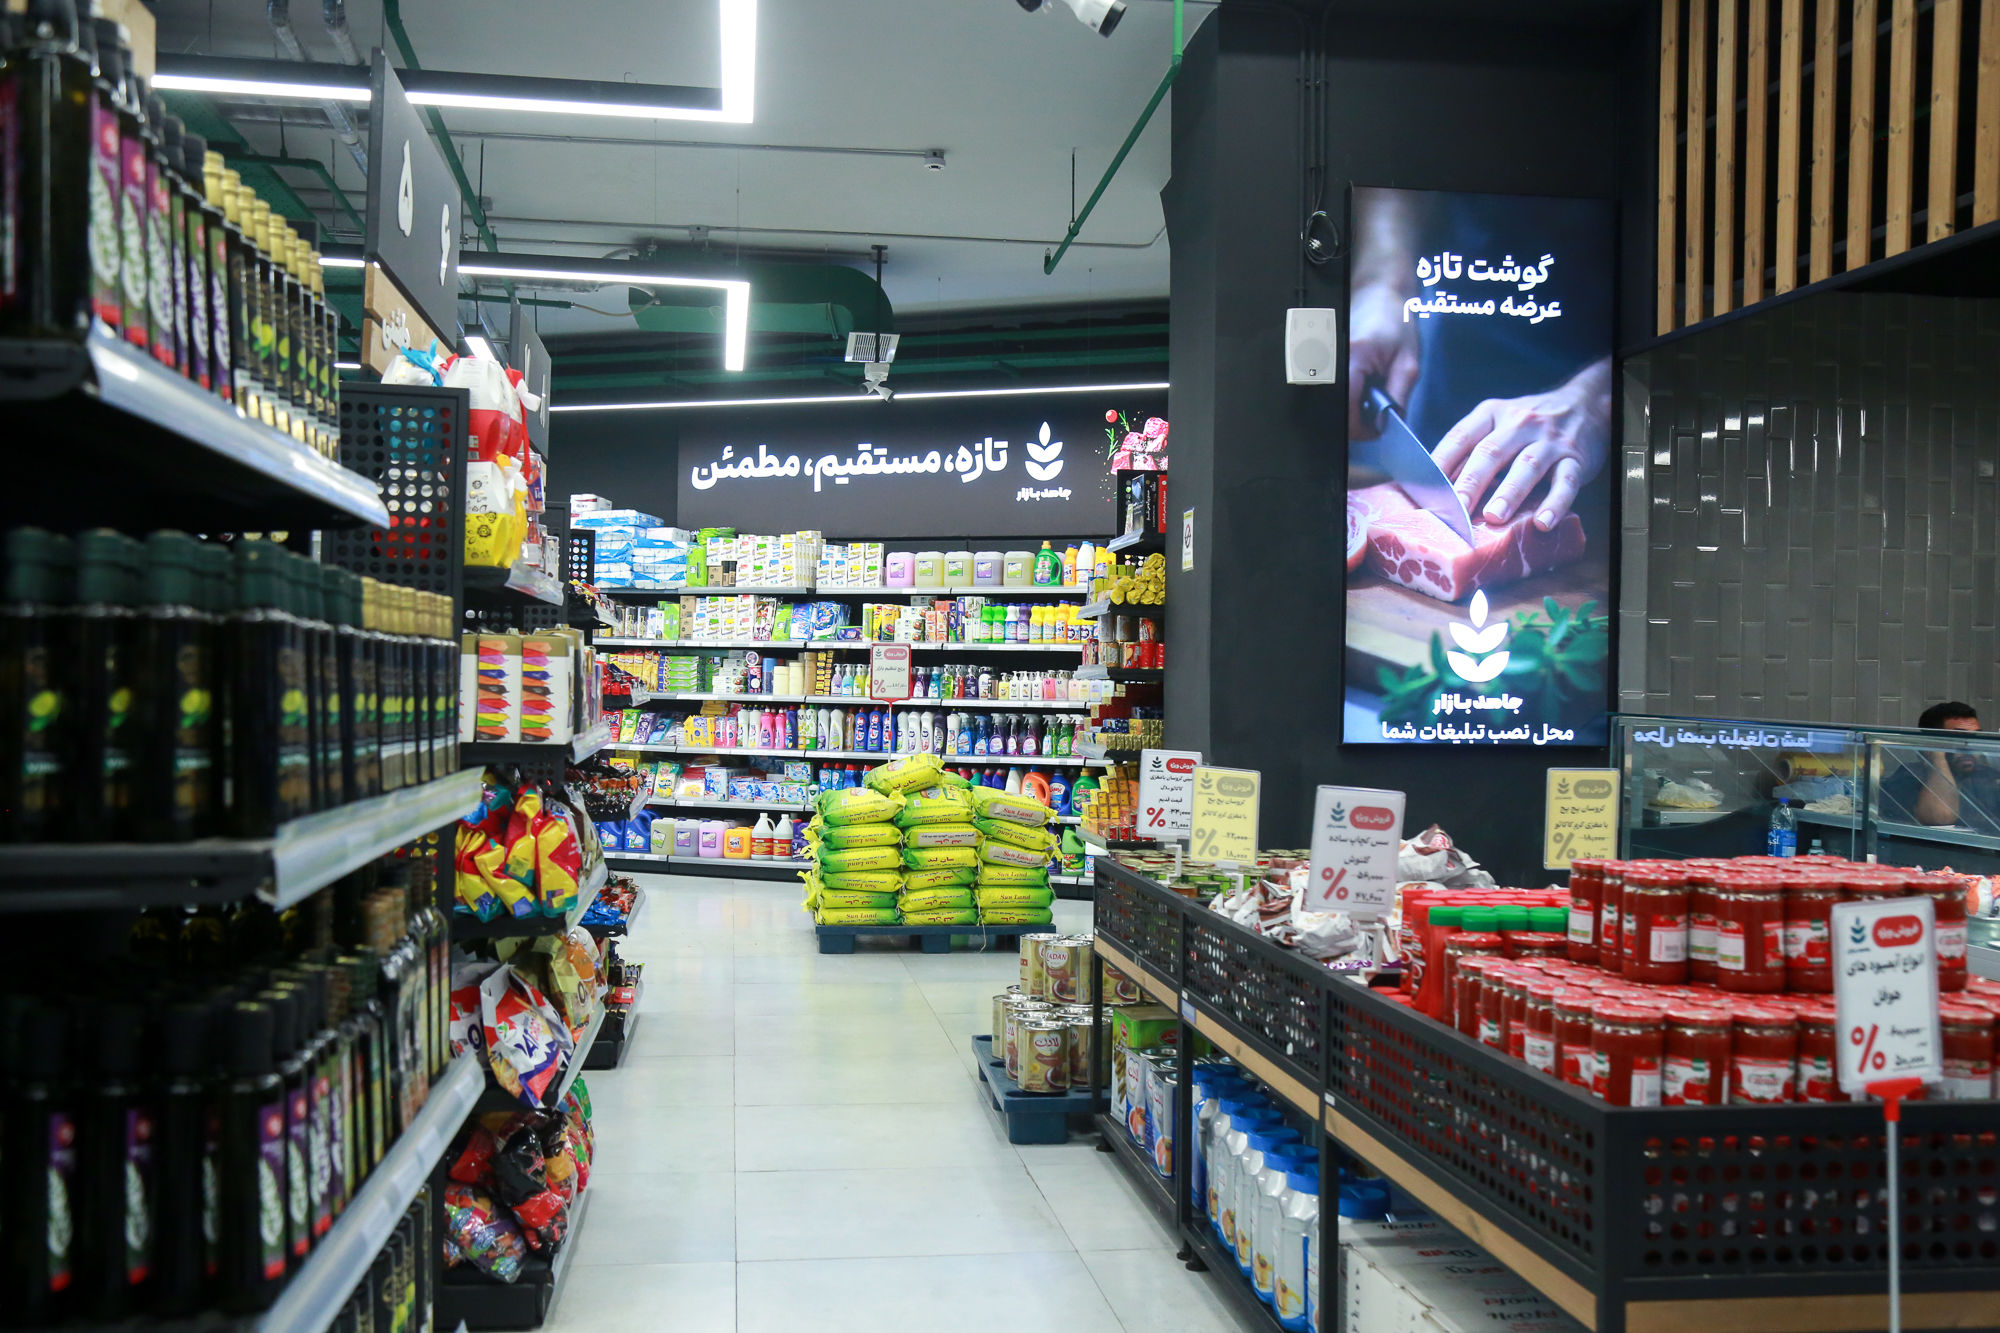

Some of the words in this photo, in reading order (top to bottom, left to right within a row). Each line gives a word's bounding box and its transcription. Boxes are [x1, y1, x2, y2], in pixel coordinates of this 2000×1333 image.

[1416, 251, 1462, 287] تازه
[1467, 253, 1555, 292] گوشت
[1403, 290, 1496, 323] مستقیم
[1500, 294, 1562, 324] عرضه
[691, 445, 800, 490] مطمئن
[804, 442, 941, 492] مستقیم،
[945, 437, 1009, 484] تازه،
[1432, 693, 1473, 716] بازار
[1381, 721, 1417, 740] شما
[1419, 722, 1486, 745] تبلیغات
[1487, 723, 1530, 745] نصب
[1532, 723, 1575, 746] محل
[1002, 807, 1017, 815] Sun
[1017, 810, 1034, 818] Land
[1003, 850, 1016, 858] Sun
[1016, 853, 1033, 862] Land
[1046, 951, 1067, 963] LADAN
